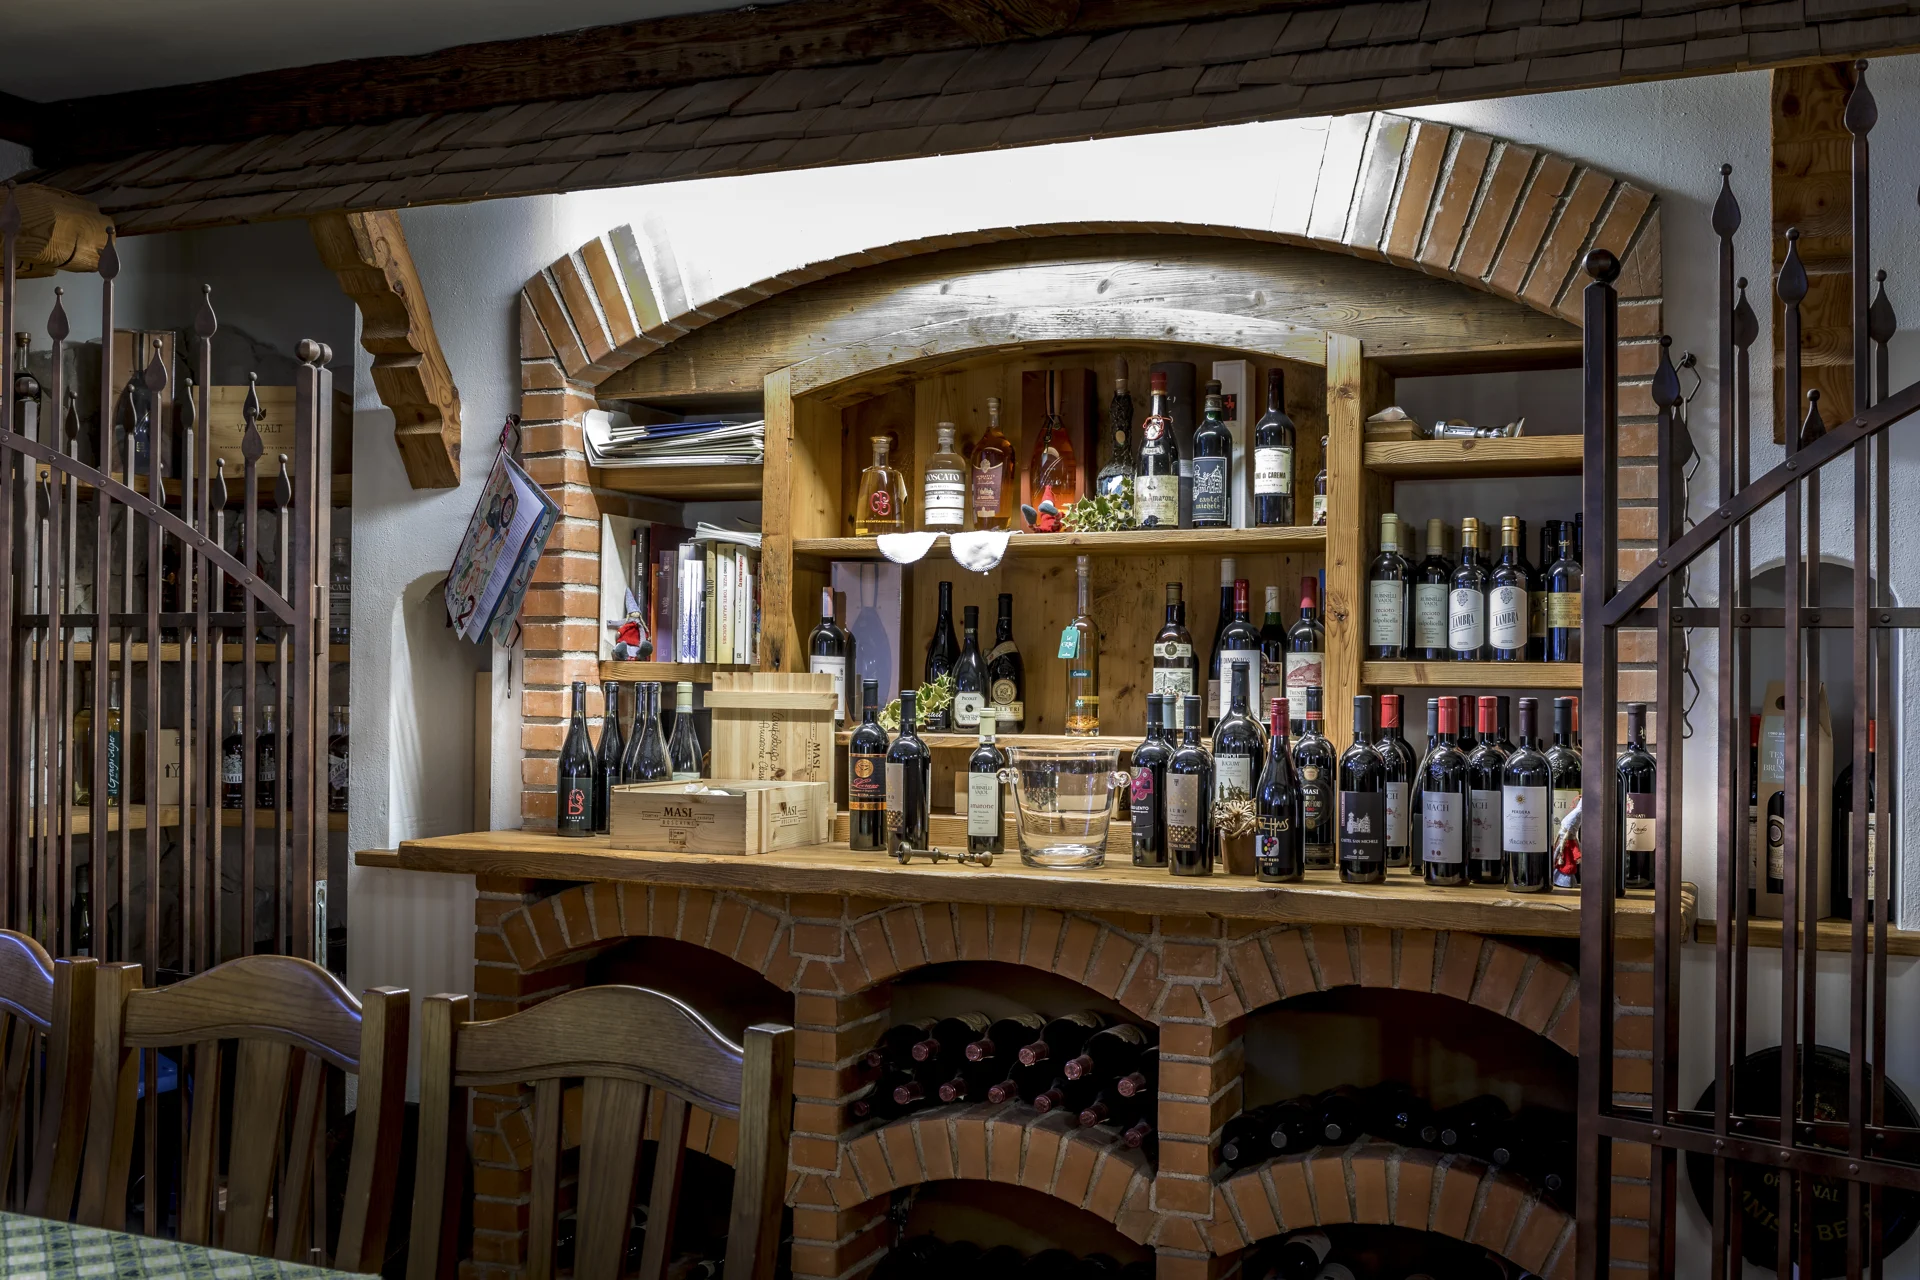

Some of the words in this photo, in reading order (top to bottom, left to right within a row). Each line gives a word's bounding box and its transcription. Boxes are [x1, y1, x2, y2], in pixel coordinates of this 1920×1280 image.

[1452, 612, 1475, 629] LAMBRA
[1495, 611, 1519, 627] LAMBRA
[812, 742, 821, 769] MASI
[781, 805, 797, 817] MASI
[1426, 803, 1449, 812] MACH
[1472, 802, 1488, 810] ACH
[1554, 801, 1567, 809] CH
[663, 806, 692, 818] MASI
